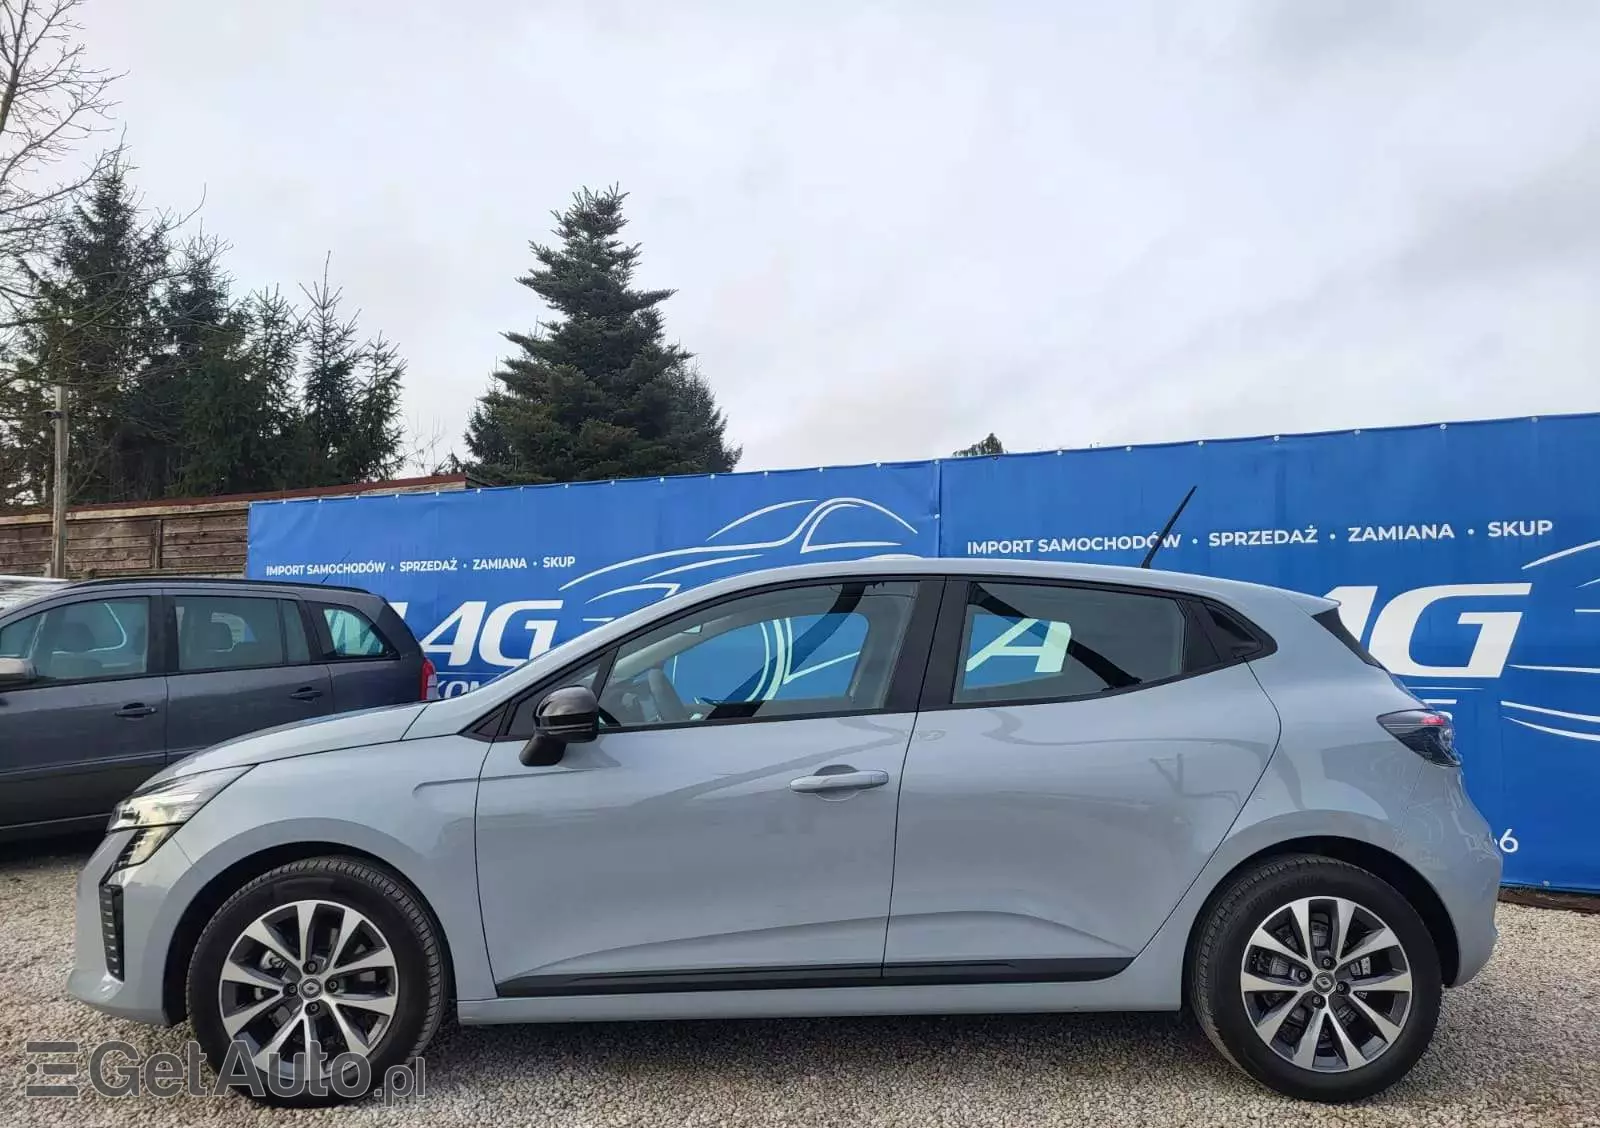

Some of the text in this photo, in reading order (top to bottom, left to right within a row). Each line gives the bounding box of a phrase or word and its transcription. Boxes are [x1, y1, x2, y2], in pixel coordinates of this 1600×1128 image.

[967, 519, 1553, 555] IMPORT SAMOCHODÓW SPRZEDAŻ ZAMIANA SKUP
[266, 555, 576, 577] IMPORT SAMOCHODÓW SPRZEDAŻ ZAMIANA SKUP
[1495, 829, 1519, 853] 6
